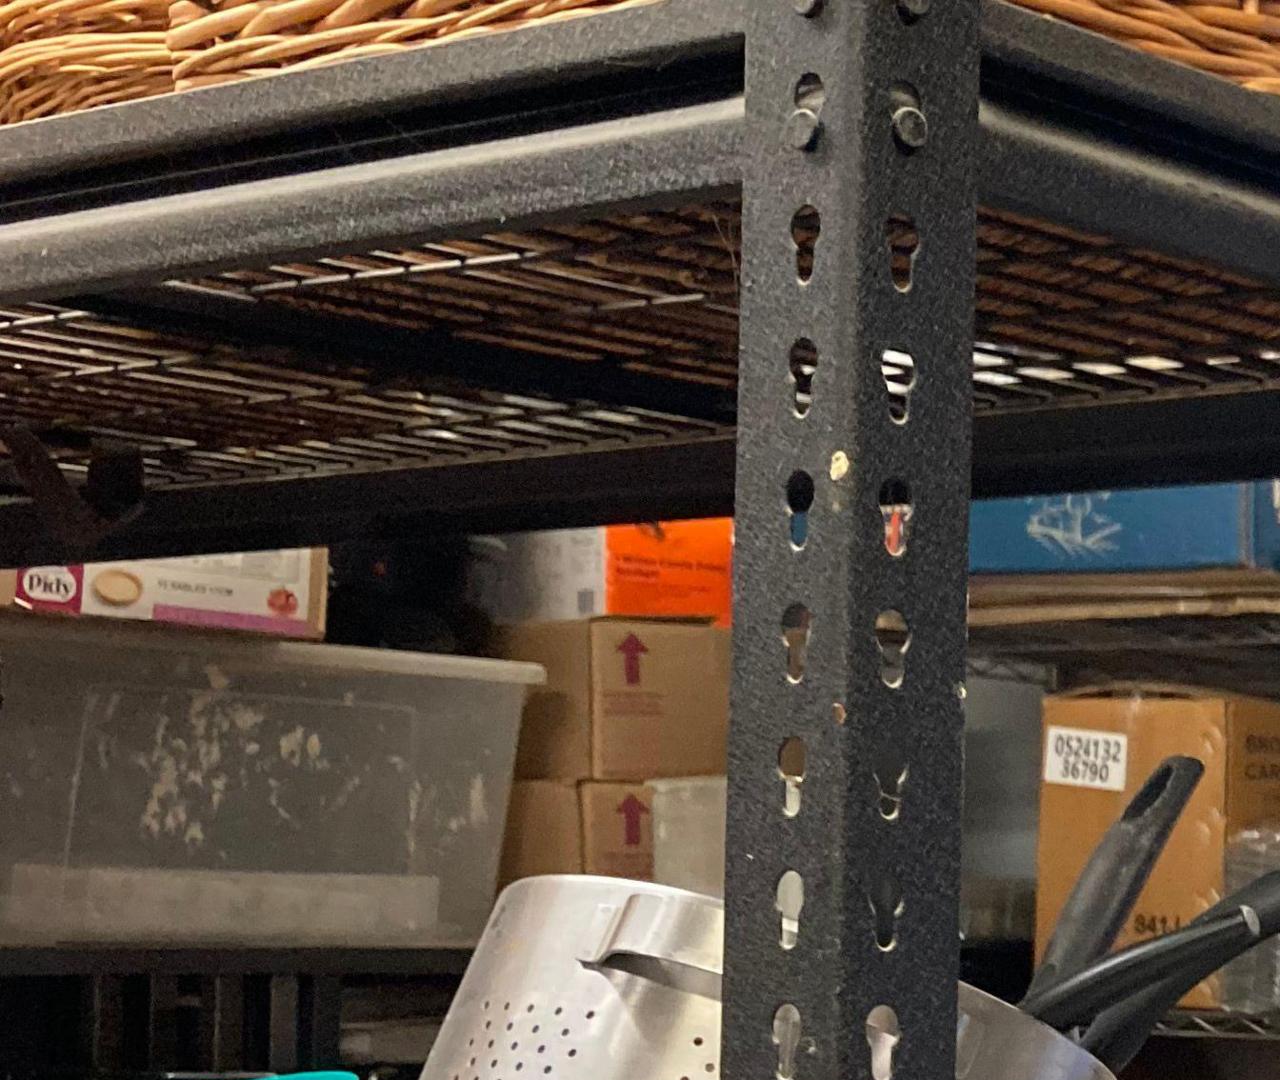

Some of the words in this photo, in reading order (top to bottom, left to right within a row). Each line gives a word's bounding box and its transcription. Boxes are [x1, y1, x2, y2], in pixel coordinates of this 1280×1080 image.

[28, 573, 74, 600] Pidy
[1054, 733, 1122, 763] 0524132
[1061, 757, 1109, 783] 36790
